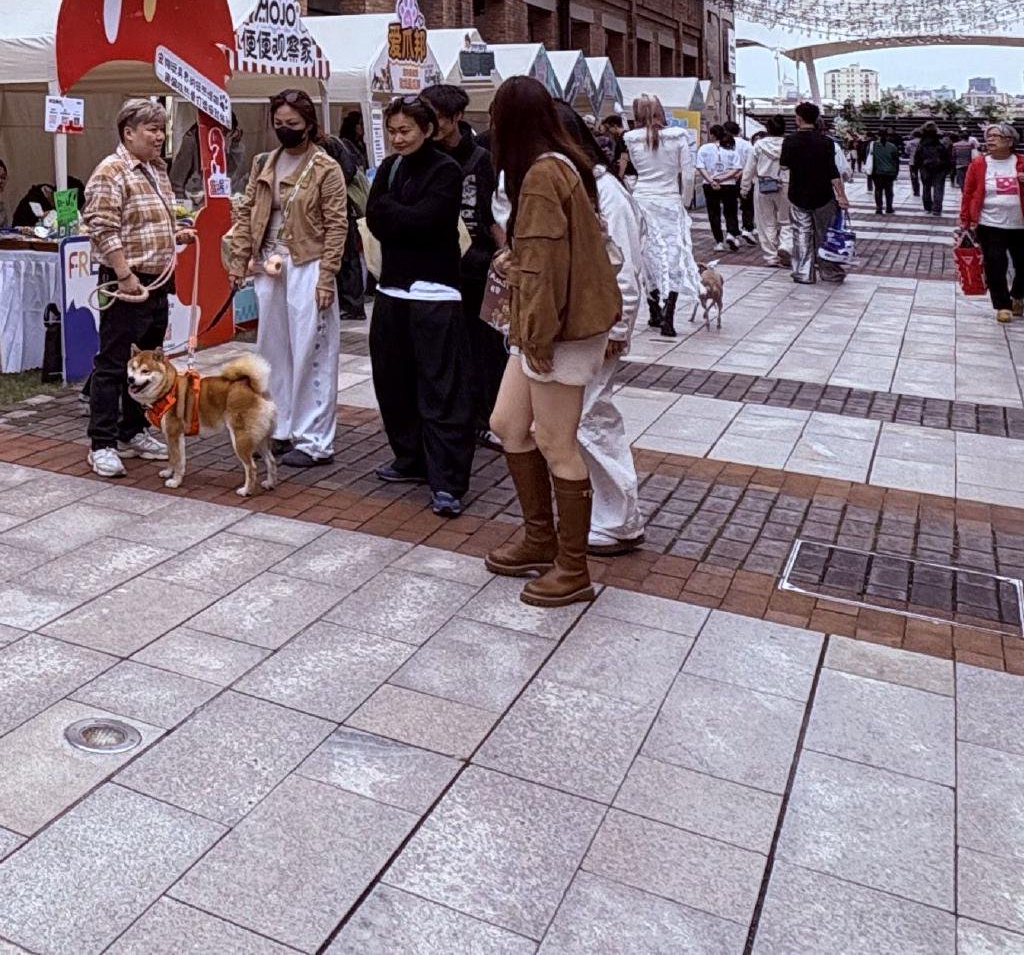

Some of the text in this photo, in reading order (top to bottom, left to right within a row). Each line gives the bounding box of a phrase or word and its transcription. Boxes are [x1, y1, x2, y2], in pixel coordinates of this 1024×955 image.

[241, 27, 313, 64] 便便观察家
